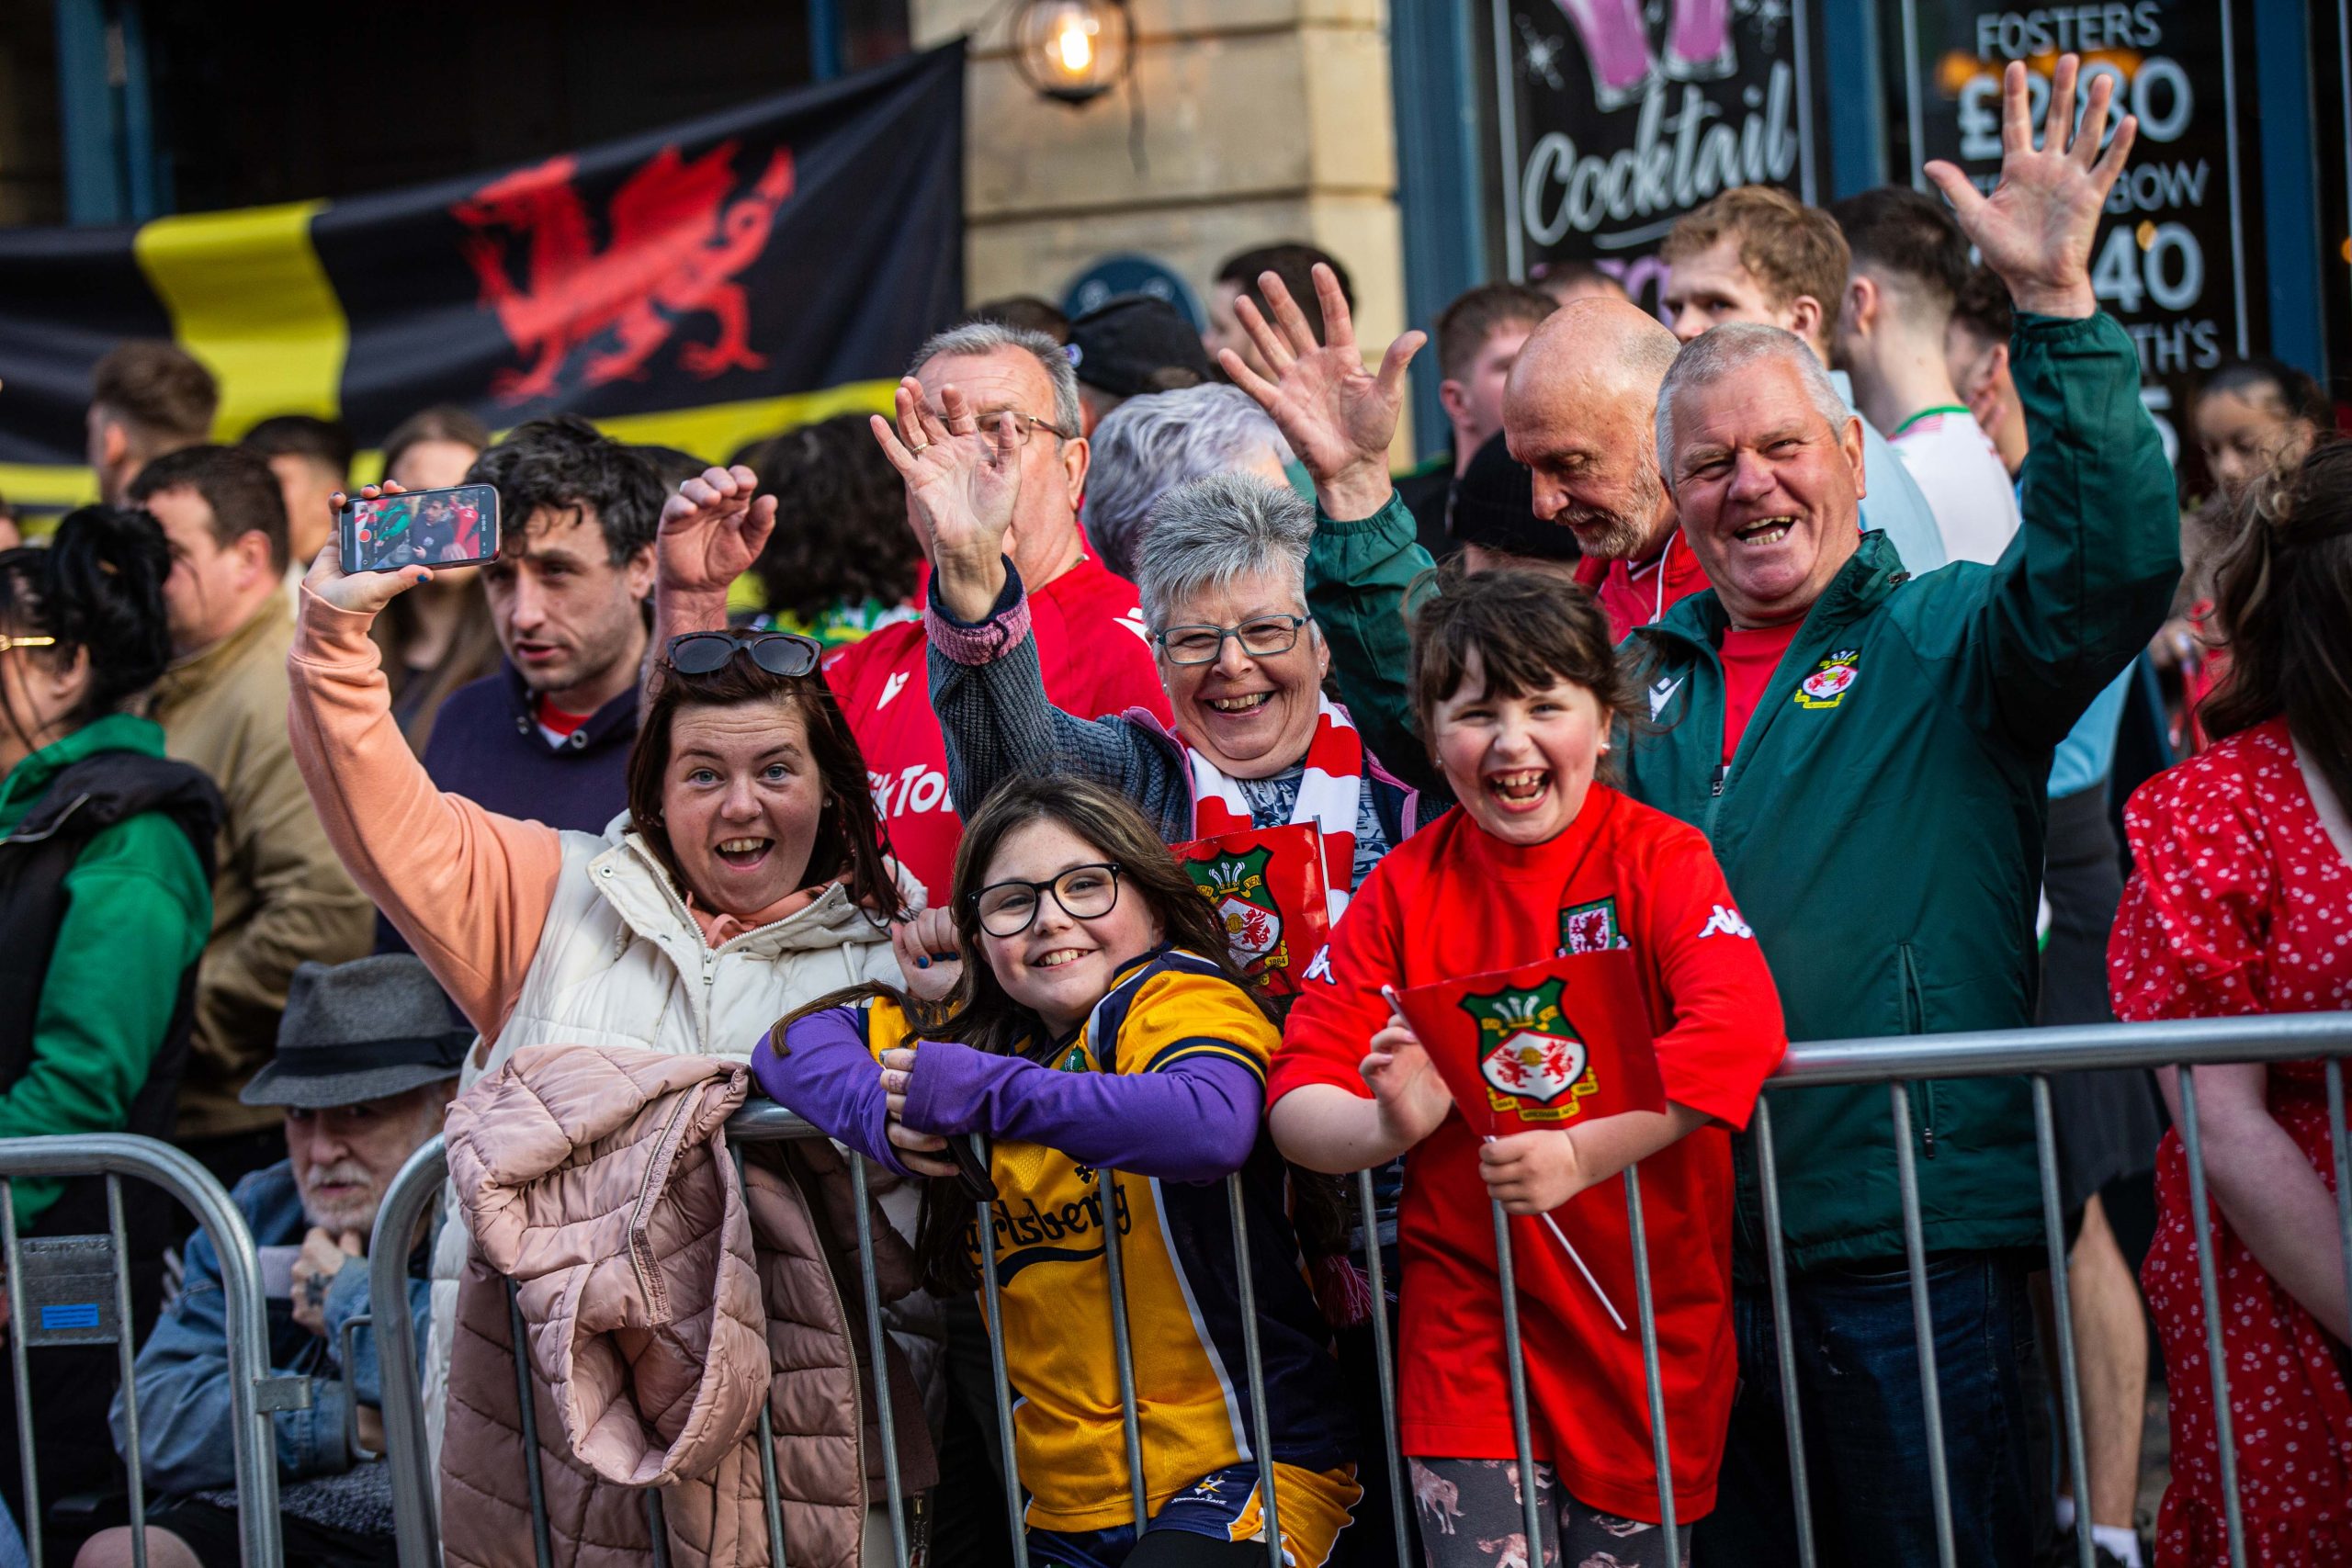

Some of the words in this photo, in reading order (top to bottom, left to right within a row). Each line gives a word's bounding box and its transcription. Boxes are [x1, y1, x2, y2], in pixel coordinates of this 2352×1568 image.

[1976, 1, 2163, 62] FOSTERS
[1523, 60, 1798, 246] Cocktail
[2130, 318, 2221, 375] TH'S
[1268, 957, 1286, 966] 1864
[966, 1184, 1132, 1255] arlsberg
